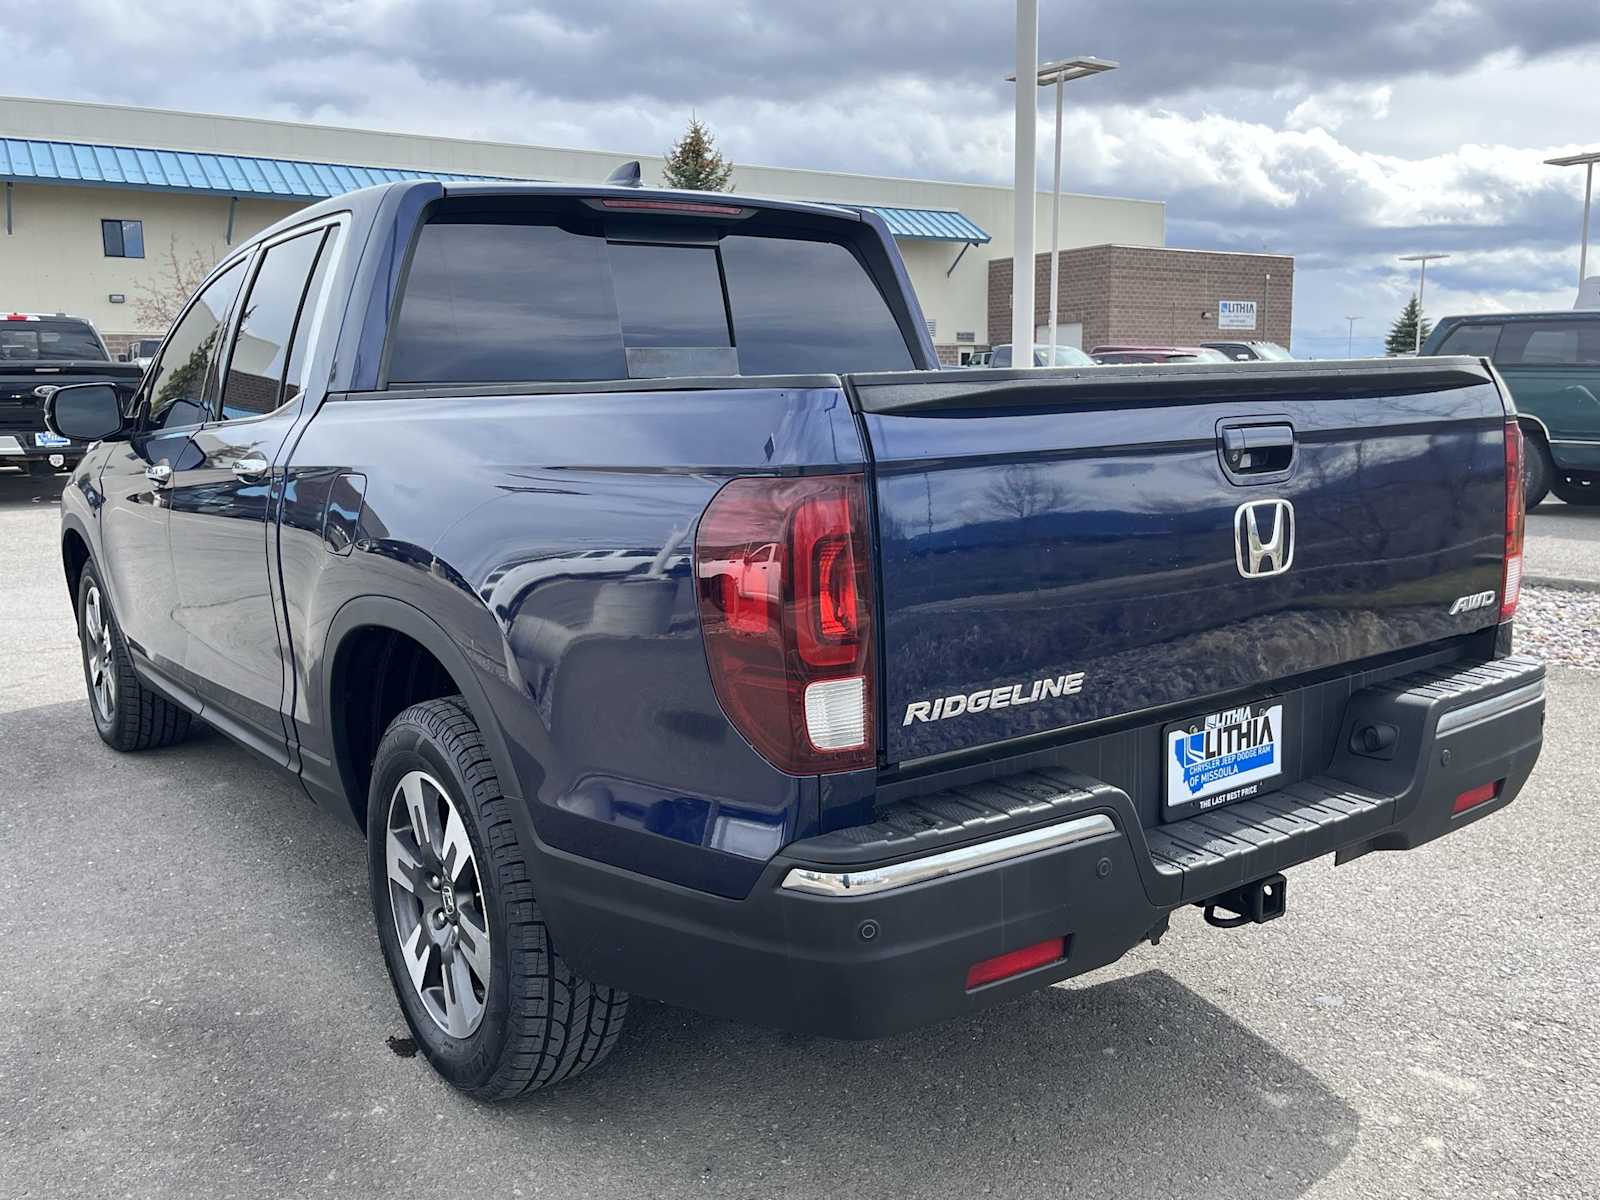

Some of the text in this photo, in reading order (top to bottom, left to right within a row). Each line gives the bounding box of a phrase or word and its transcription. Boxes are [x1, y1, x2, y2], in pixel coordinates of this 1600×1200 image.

[1228, 303, 1255, 313] LITHIA
[1449, 590, 1496, 615] AWD
[903, 672, 1085, 727] RIDGELINE
[1216, 706, 1251, 727] LITHIA
[1205, 716, 1274, 760] LITHIA
[1189, 745, 1272, 776] CHRYSLER JEEP DODGE RAM
[1189, 763, 1239, 787] OF MISSOULA
[1200, 785, 1258, 809] THE LAST BEST PRICE
